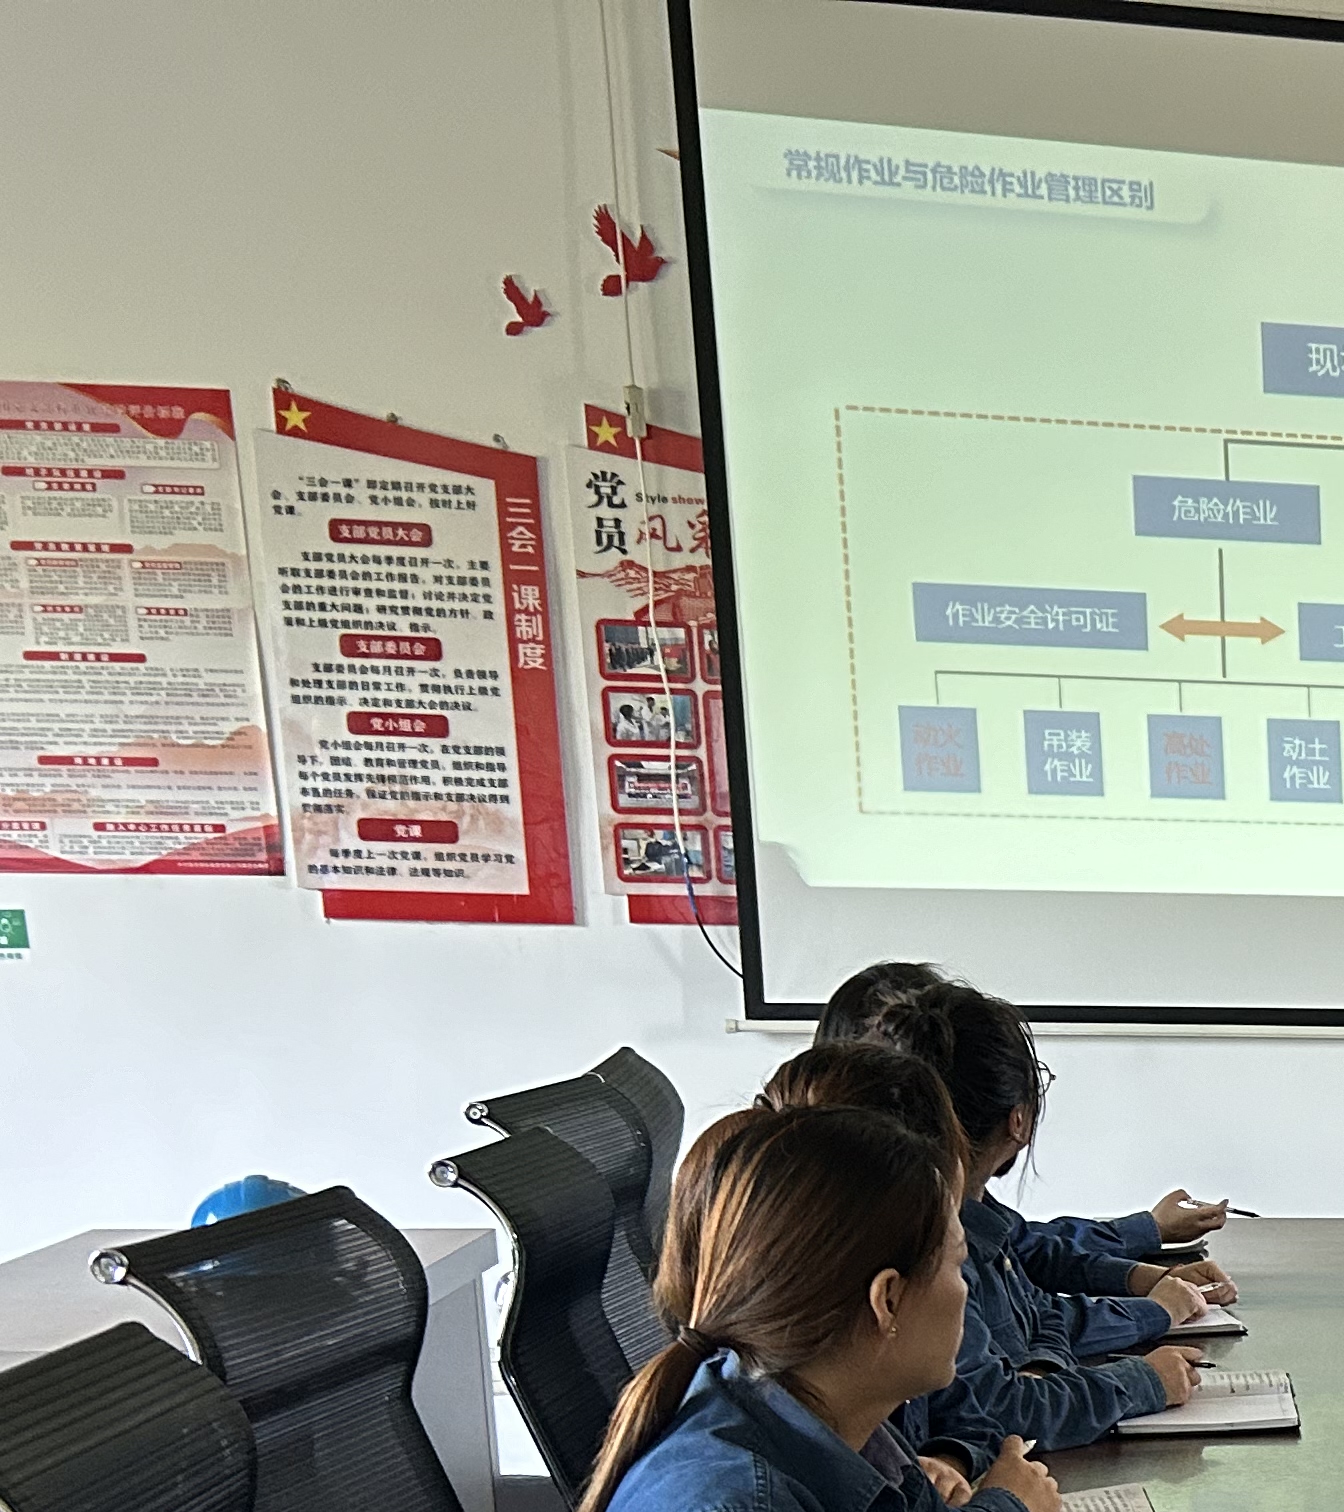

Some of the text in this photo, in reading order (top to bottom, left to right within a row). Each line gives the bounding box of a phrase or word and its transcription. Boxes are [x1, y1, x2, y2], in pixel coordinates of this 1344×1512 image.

[783, 148, 1155, 211] 常规作业与危险作业管理区别
[636, 492, 705, 505] Style show
[1172, 494, 1279, 528] 危险作业
[586, 470, 628, 555] 党员
[338, 524, 423, 542] 支部党员大会
[505, 497, 548, 671] 三会一课制度
[945, 600, 1120, 634] 作业安全许可证
[356, 640, 427, 656] 支部委员会
[369, 717, 427, 733] 党小组会
[911, 722, 964, 748] 动火
[1043, 729, 1093, 755] 吊装
[1162, 731, 1214, 758] 高处
[1282, 737, 1330, 761] 动土
[914, 752, 965, 778] 作业
[1043, 758, 1094, 783] 作业
[1163, 760, 1214, 786] 作业
[1282, 764, 1332, 789] 作业
[393, 824, 422, 838] 党课
